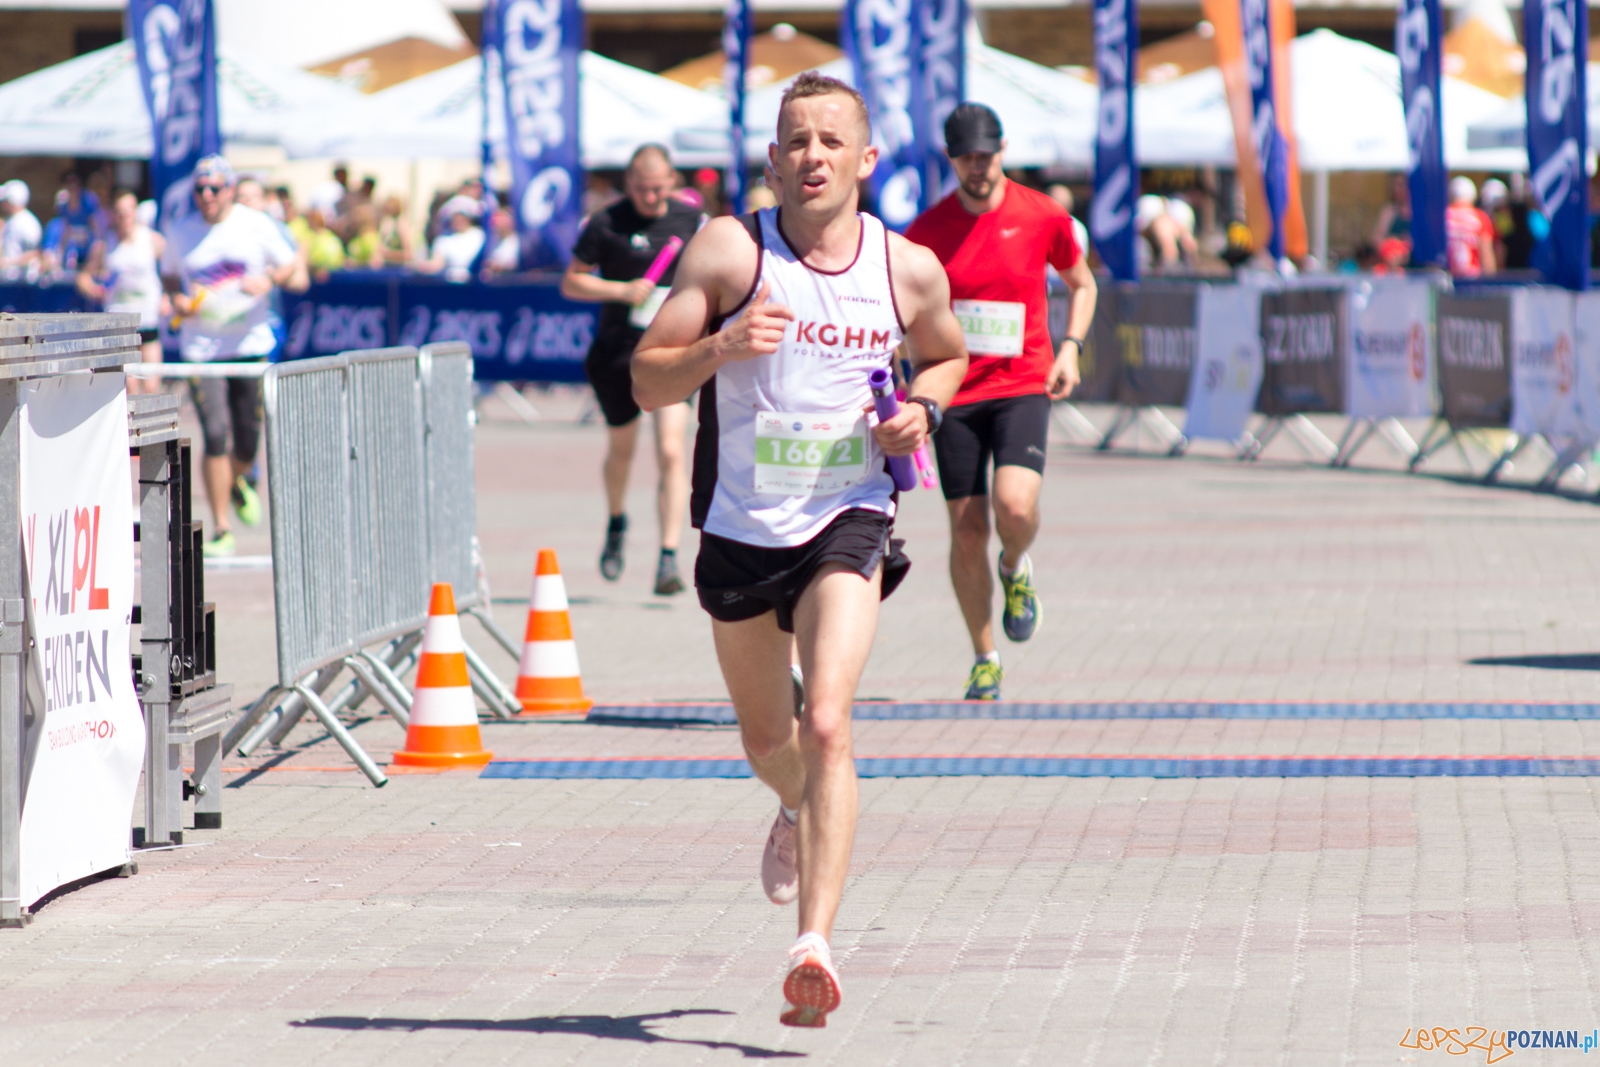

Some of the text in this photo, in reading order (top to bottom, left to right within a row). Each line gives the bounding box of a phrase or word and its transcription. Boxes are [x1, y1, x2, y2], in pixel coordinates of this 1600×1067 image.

[795, 320, 891, 351] KGHM
[960, 317, 1011, 335] 218/2
[769, 440, 852, 466] 166/2
[45, 504, 109, 616] XLPL
[45, 629, 113, 713] EKIDEN
